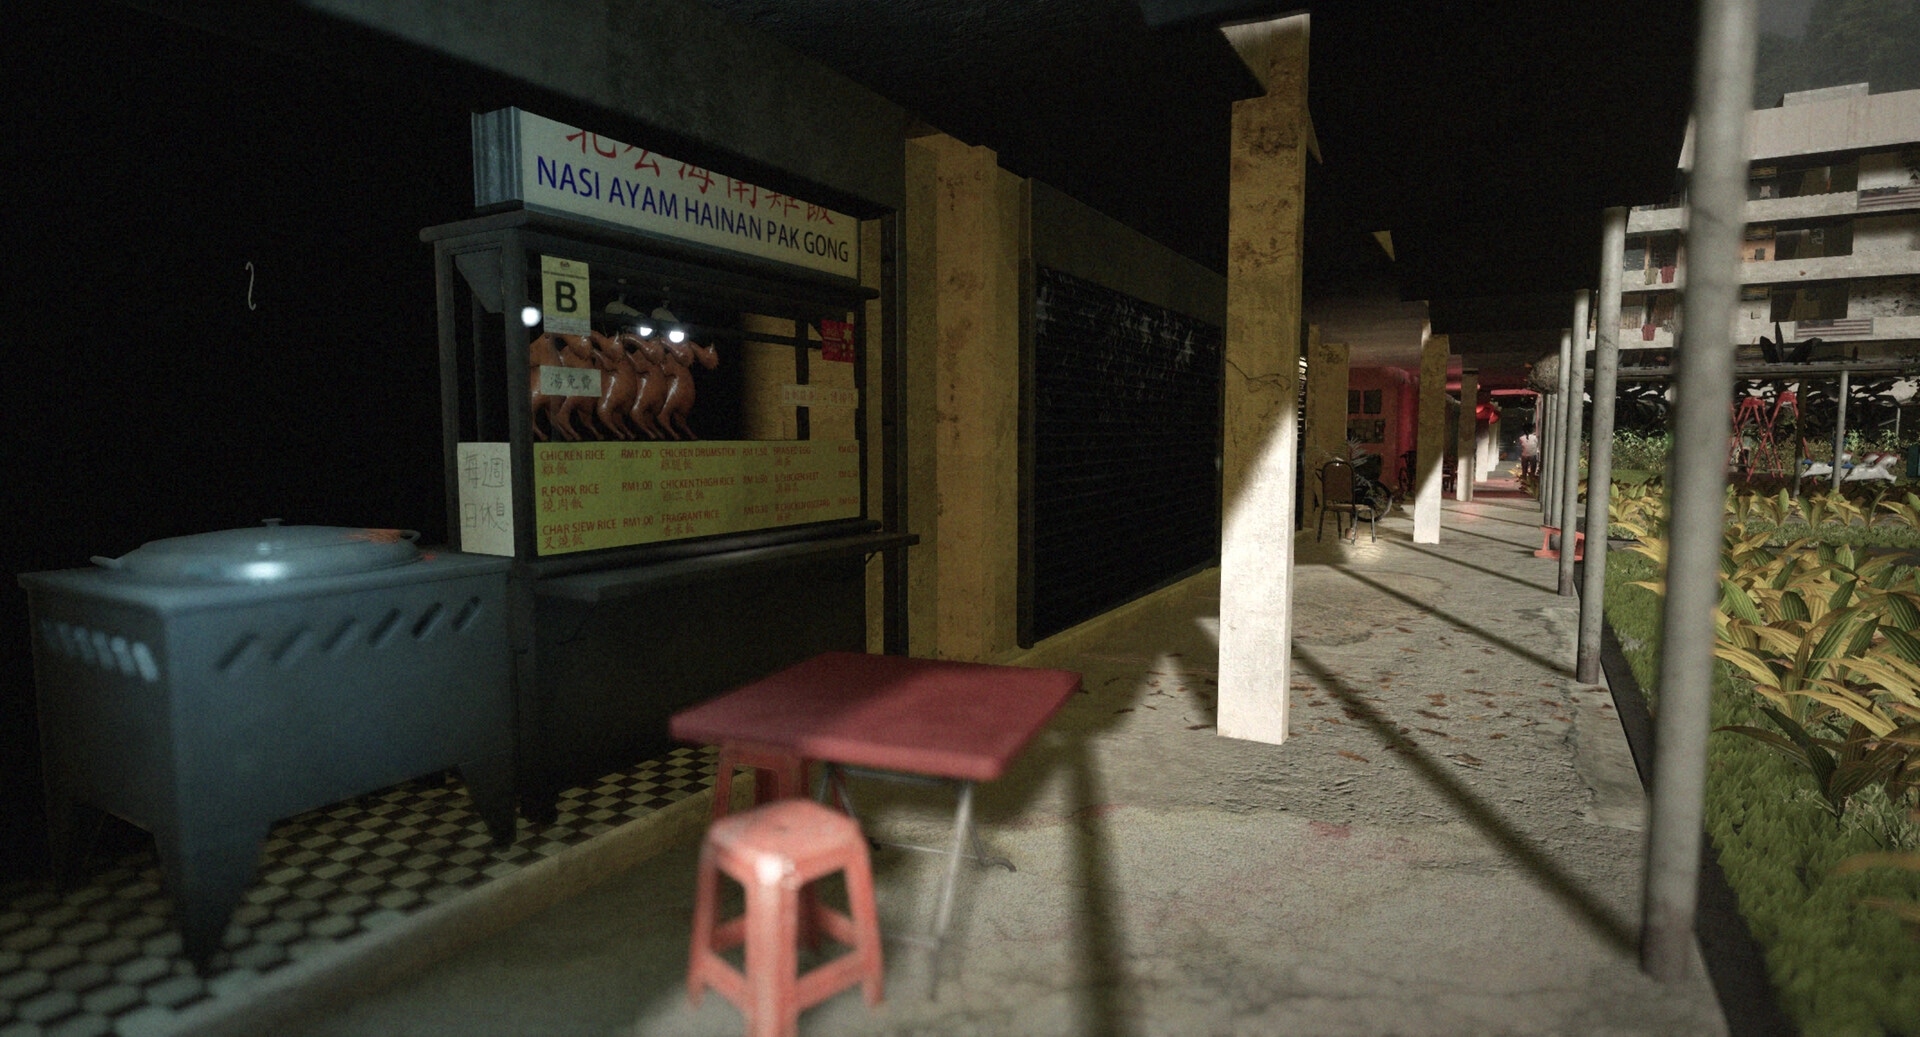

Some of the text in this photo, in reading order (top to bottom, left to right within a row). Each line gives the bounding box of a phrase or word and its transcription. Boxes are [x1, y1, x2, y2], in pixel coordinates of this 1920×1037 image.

[537, 155, 849, 262] NASI AYAM HAINAN PAK GONG
[555, 281, 578, 313] B
[540, 450, 583, 461] CHICKEN
[585, 449, 606, 460] RICE
[621, 449, 653, 459] RM1.00
[660, 448, 694, 459] CHICKEN
[580, 483, 600, 495] RICE
[622, 481, 653, 492] RM1.00
[660, 479, 695, 490] CHICKEN
[719, 476, 735, 486] RICE
[542, 524, 570, 536] CHAR
[572, 521, 596, 533] SIEW
[597, 518, 617, 530] RICE
[622, 515, 654, 527] RM1.00
[661, 510, 703, 523] FRAGRANT
[703, 509, 720, 519] RICE
